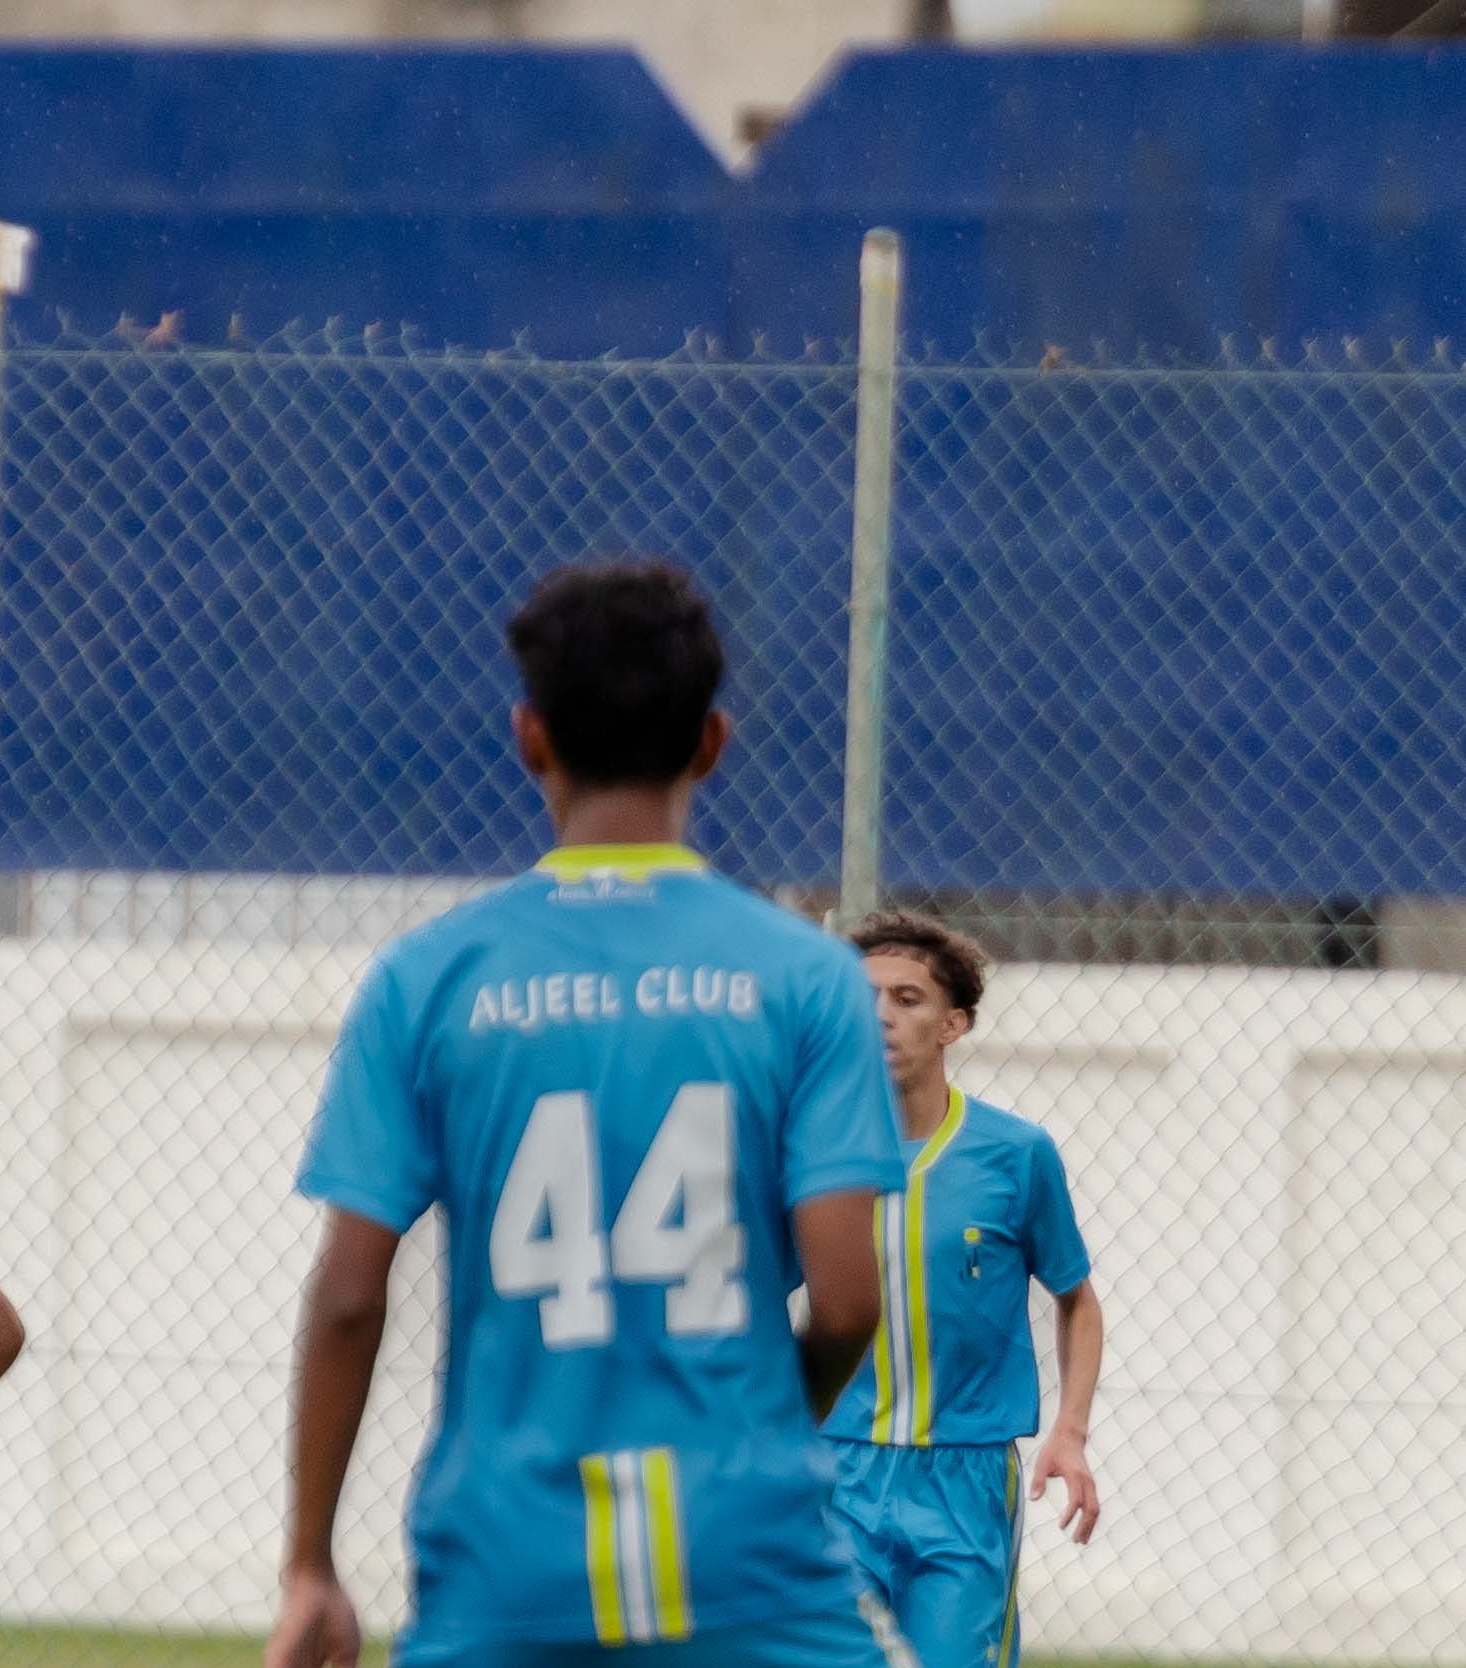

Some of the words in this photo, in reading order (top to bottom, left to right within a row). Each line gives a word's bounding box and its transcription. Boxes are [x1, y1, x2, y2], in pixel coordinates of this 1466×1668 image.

[470, 972, 620, 1033] ALJEEL
[635, 964, 756, 1018] CLUB
[489, 1081, 751, 1350] 44
